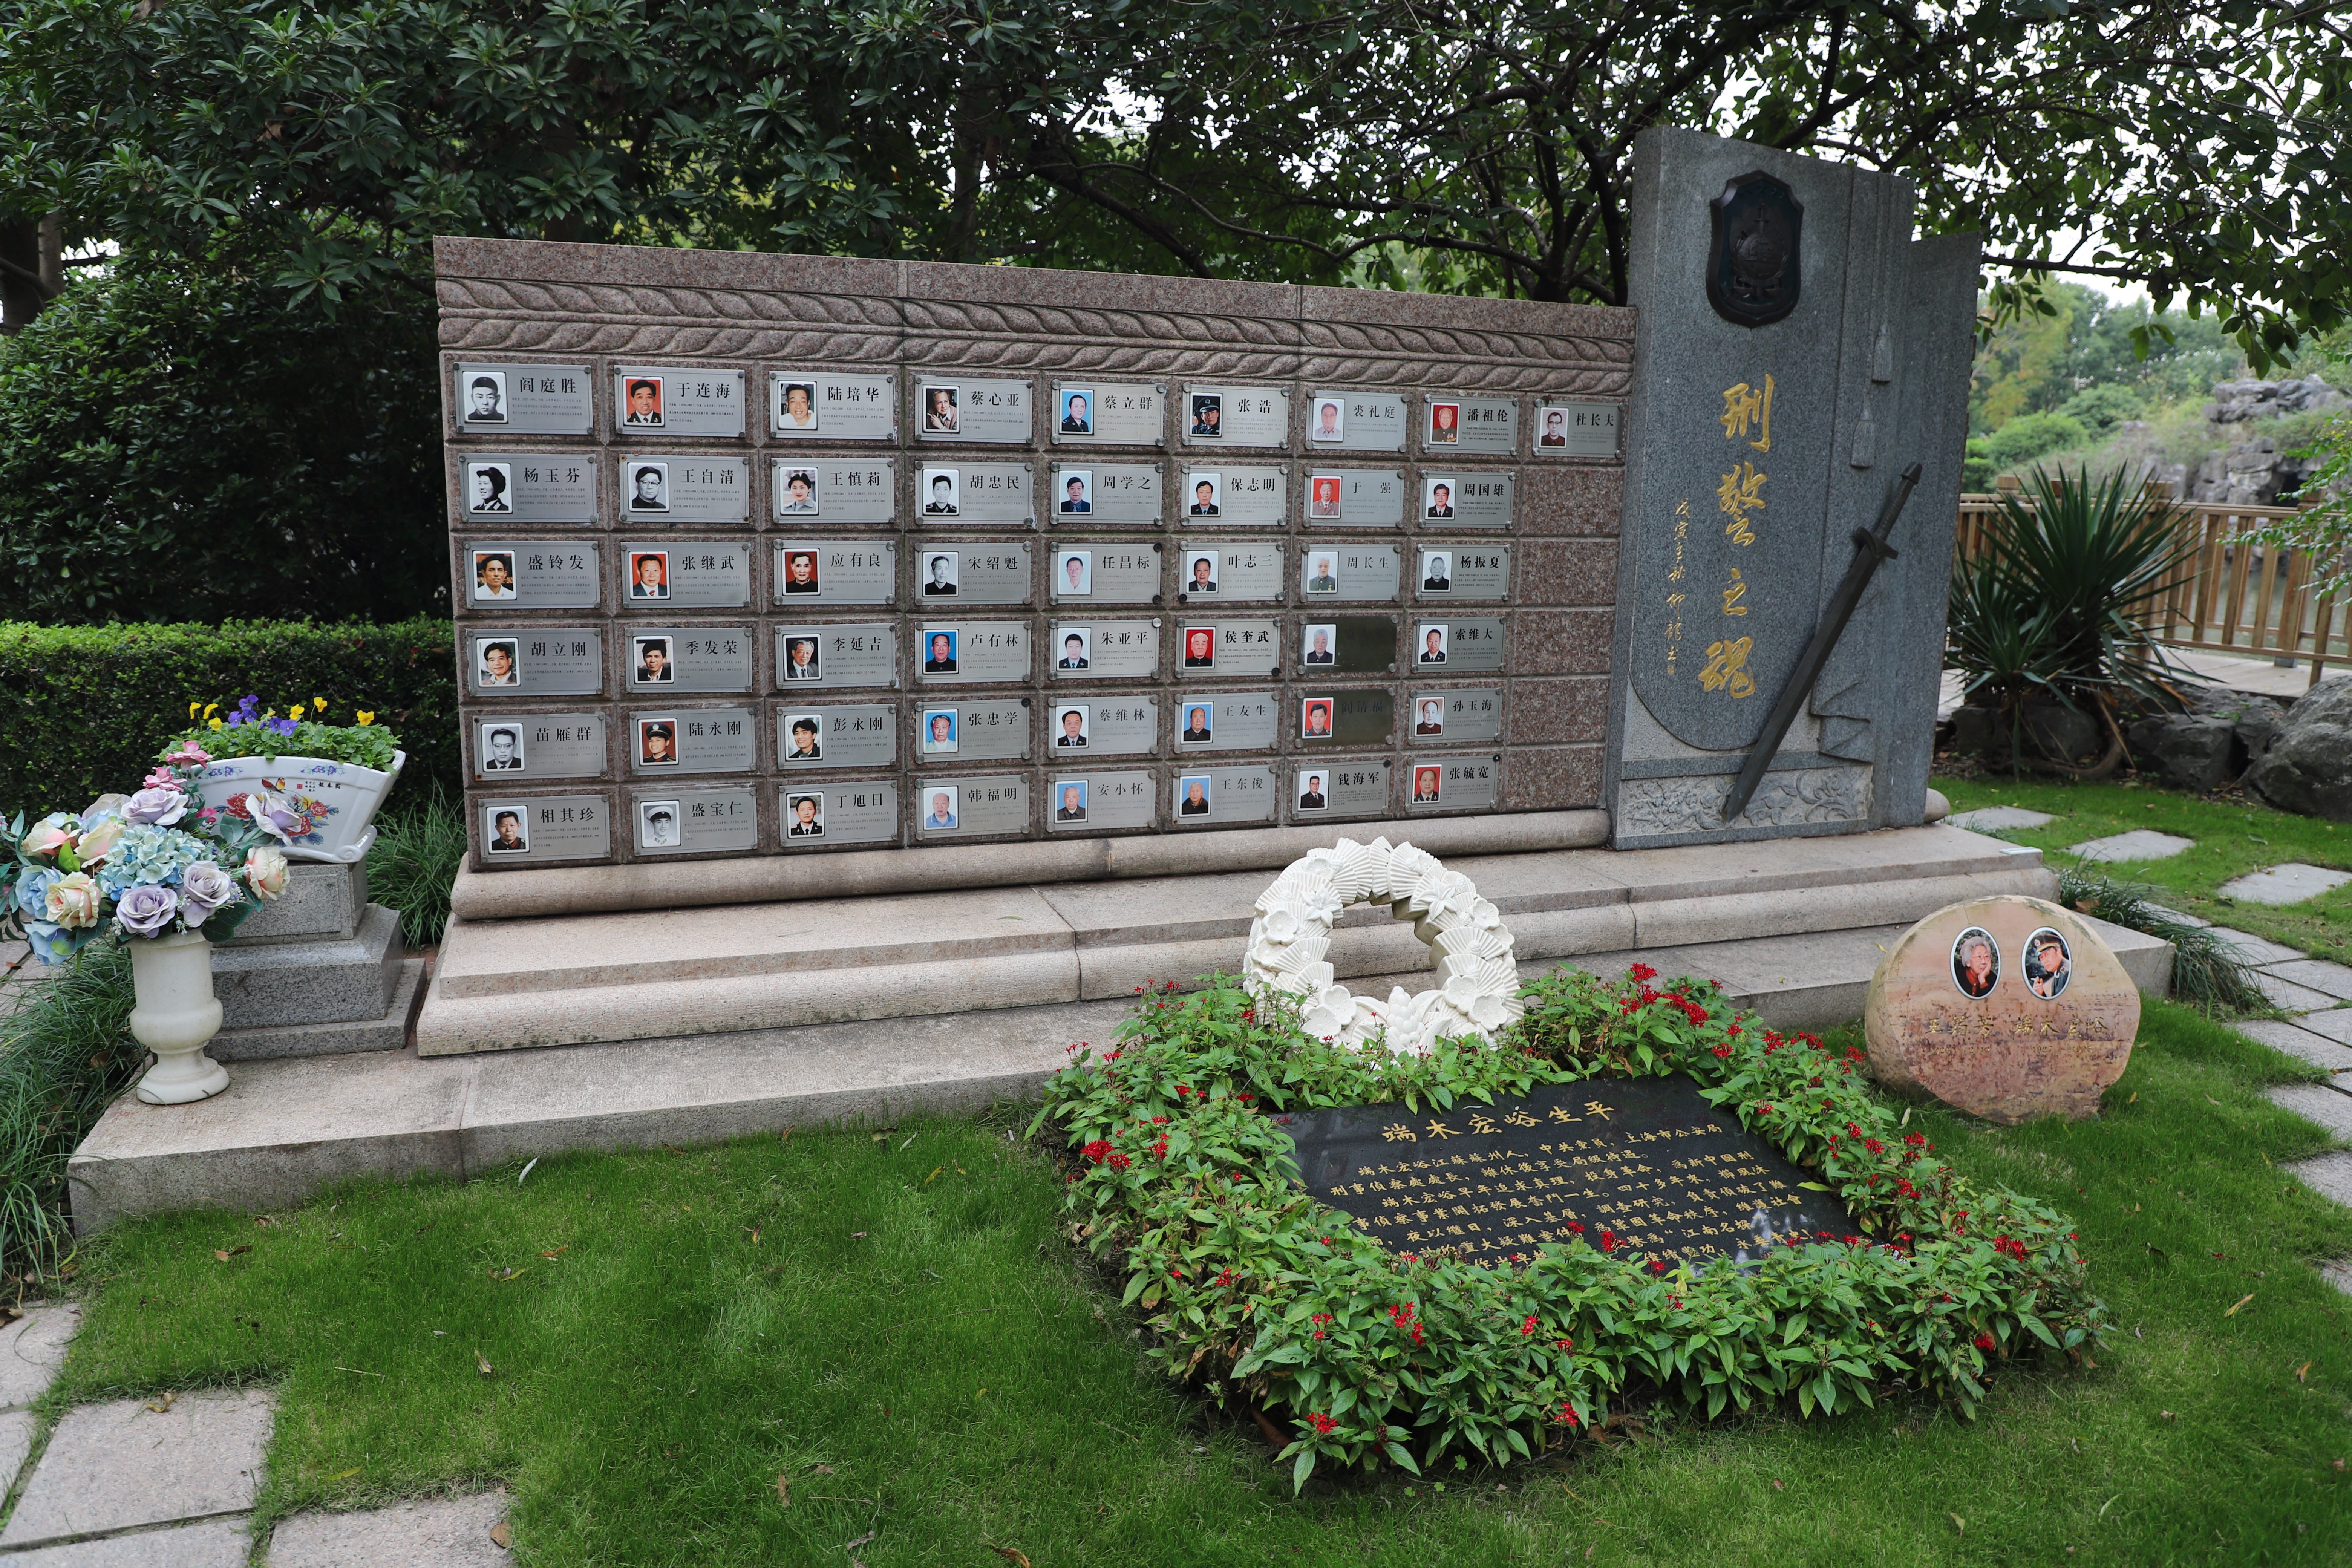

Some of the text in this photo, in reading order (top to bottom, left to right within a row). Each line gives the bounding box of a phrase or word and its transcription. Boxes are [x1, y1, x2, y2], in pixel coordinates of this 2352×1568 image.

[520, 377, 577, 394] 阎庭胜
[676, 383, 730, 398] 于连海
[828, 386, 879, 402] 陆培华
[971, 391, 1019, 406] 蔡心亚
[1104, 395, 1152, 410] 蔡立群
[1238, 398, 1272, 413] 张浩
[1467, 408, 1508, 422] 潘祖伦
[1576, 413, 1614, 427] 杜长夫
[524, 467, 580, 483] 杨玉芬
[681, 469, 734, 484] 王自清
[830, 472, 880, 486] 王慎莉
[970, 475, 1019, 489] 胡忠民
[1103, 476, 1151, 490] 周学之
[1231, 478, 1275, 492] 保志明
[1351, 482, 1390, 494] 于强
[1464, 483, 1504, 497] 周国雄
[1697, 373, 1775, 699] 刑警之魂
[528, 554, 584, 570] 盛铃发
[682, 555, 735, 570] 张继武
[831, 553, 881, 567] 应有良
[969, 556, 1018, 570] 宋绍魁
[1102, 556, 1150, 569] 任昌标
[1228, 554, 1272, 568] 叶志三
[1347, 556, 1389, 568] 周长生
[1460, 555, 1501, 568] 杨振夏
[970, 634, 1018, 648] 卢有林
[1101, 632, 1148, 645] 朱亚平
[1225, 631, 1269, 643] 侯奎武
[1455, 628, 1493, 641] 索维大
[531, 642, 586, 657] 胡立刚
[685, 640, 737, 655] 季发荣
[832, 637, 881, 652] 李延吉
[1223, 705, 1266, 716] 王友生
[1453, 699, 1492, 712] 孙玉海
[969, 712, 1018, 726] 张忠学
[1100, 708, 1145, 721] 蔡维林
[689, 721, 741, 737] 陆永刚
[833, 717, 882, 732] 彭永刚
[536, 727, 591, 742] 苗雁群
[1338, 772, 1379, 786] 钱海军
[1450, 766, 1488, 780] 张毓宽
[1098, 782, 1143, 796] 安小怀
[1221, 777, 1263, 790] 王东俊
[836, 793, 882, 808] 丁旭日
[968, 787, 1017, 802] 韩福明
[540, 807, 594, 823] 相其珍
[692, 801, 743, 817] 盛宝仁
[1381, 1100, 1615, 1142] 端木宏峪生平
